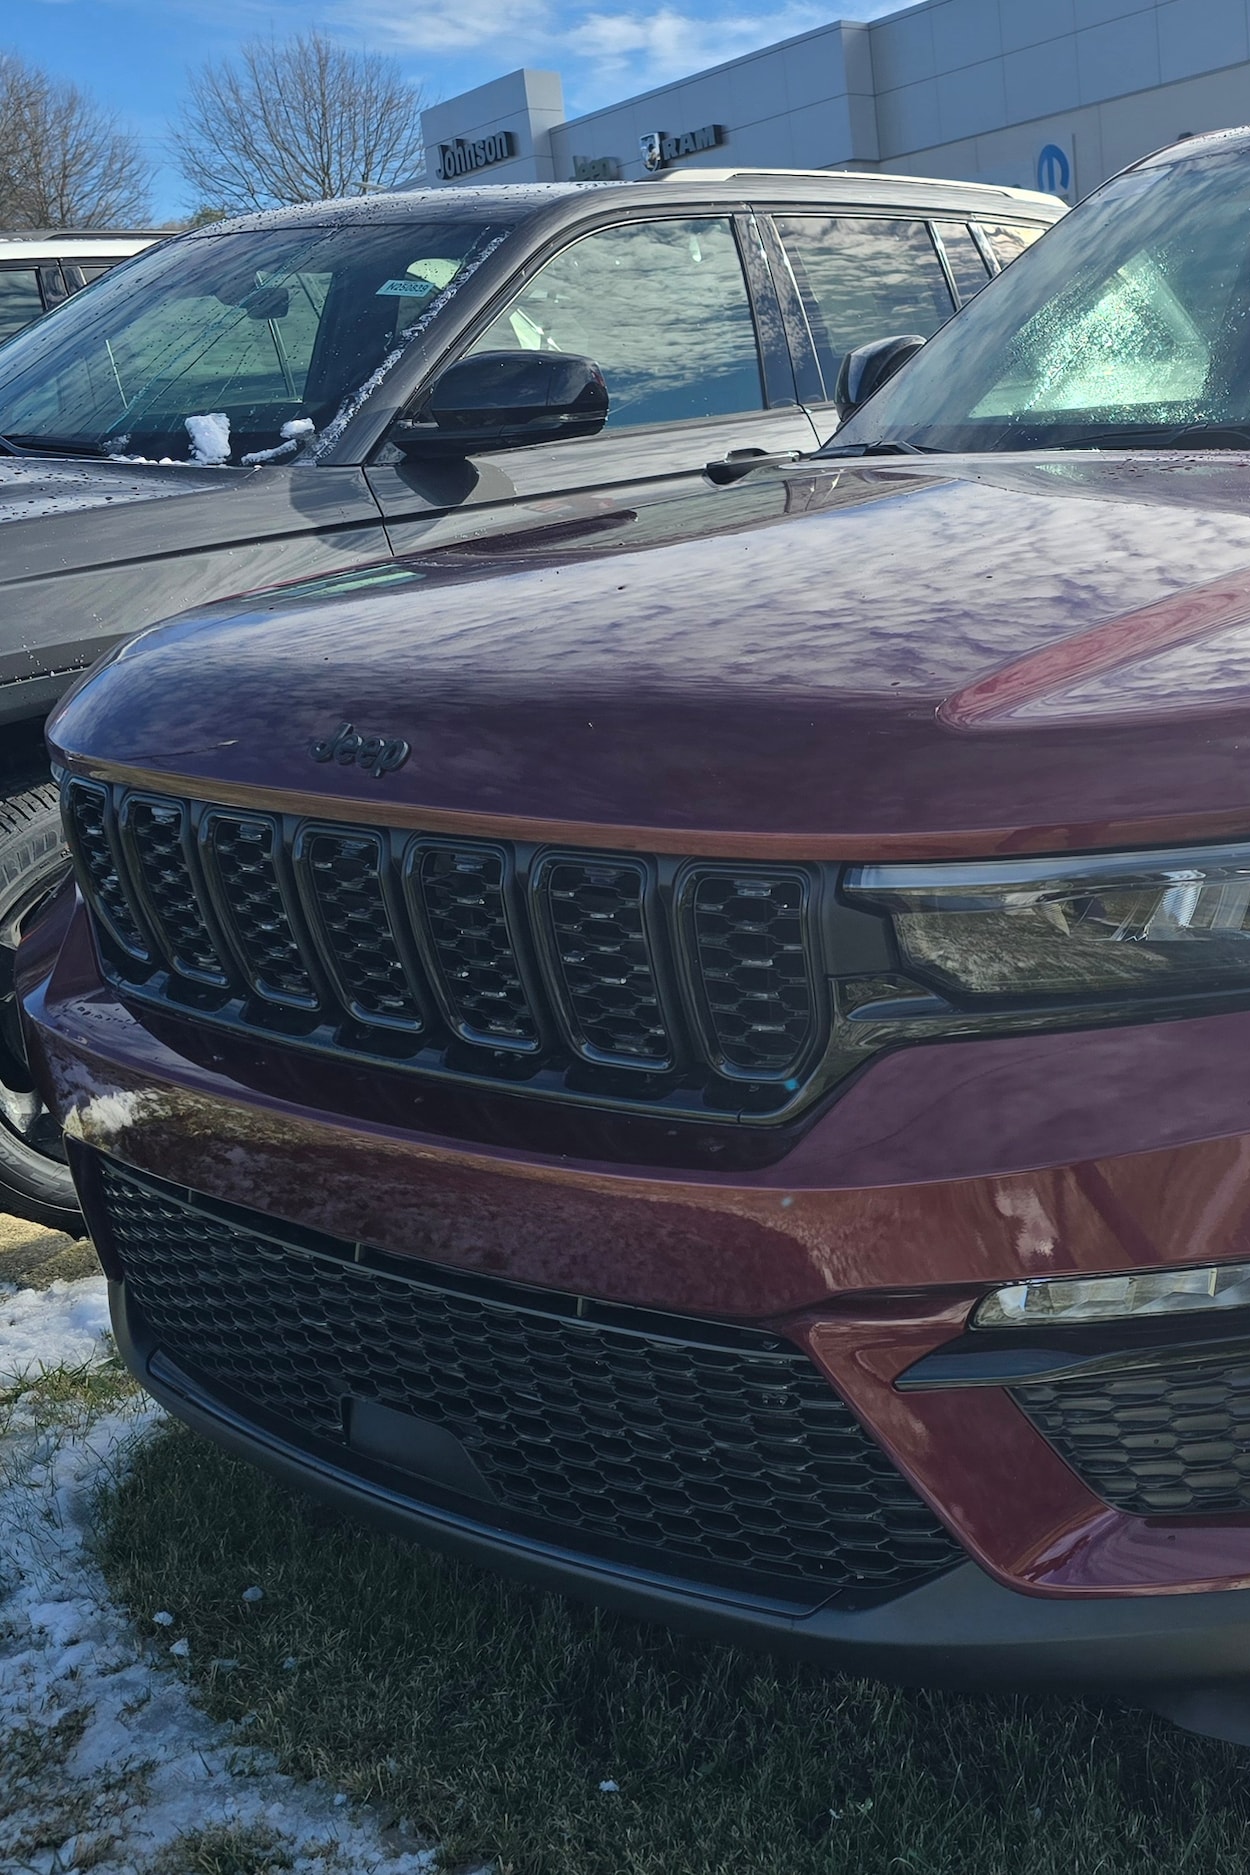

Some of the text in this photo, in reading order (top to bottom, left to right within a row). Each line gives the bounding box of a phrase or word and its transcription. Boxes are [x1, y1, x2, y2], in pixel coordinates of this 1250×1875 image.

[435, 131, 509, 179] Johnson
[662, 126, 716, 160] RAM
[309, 723, 410, 777] Jeep
